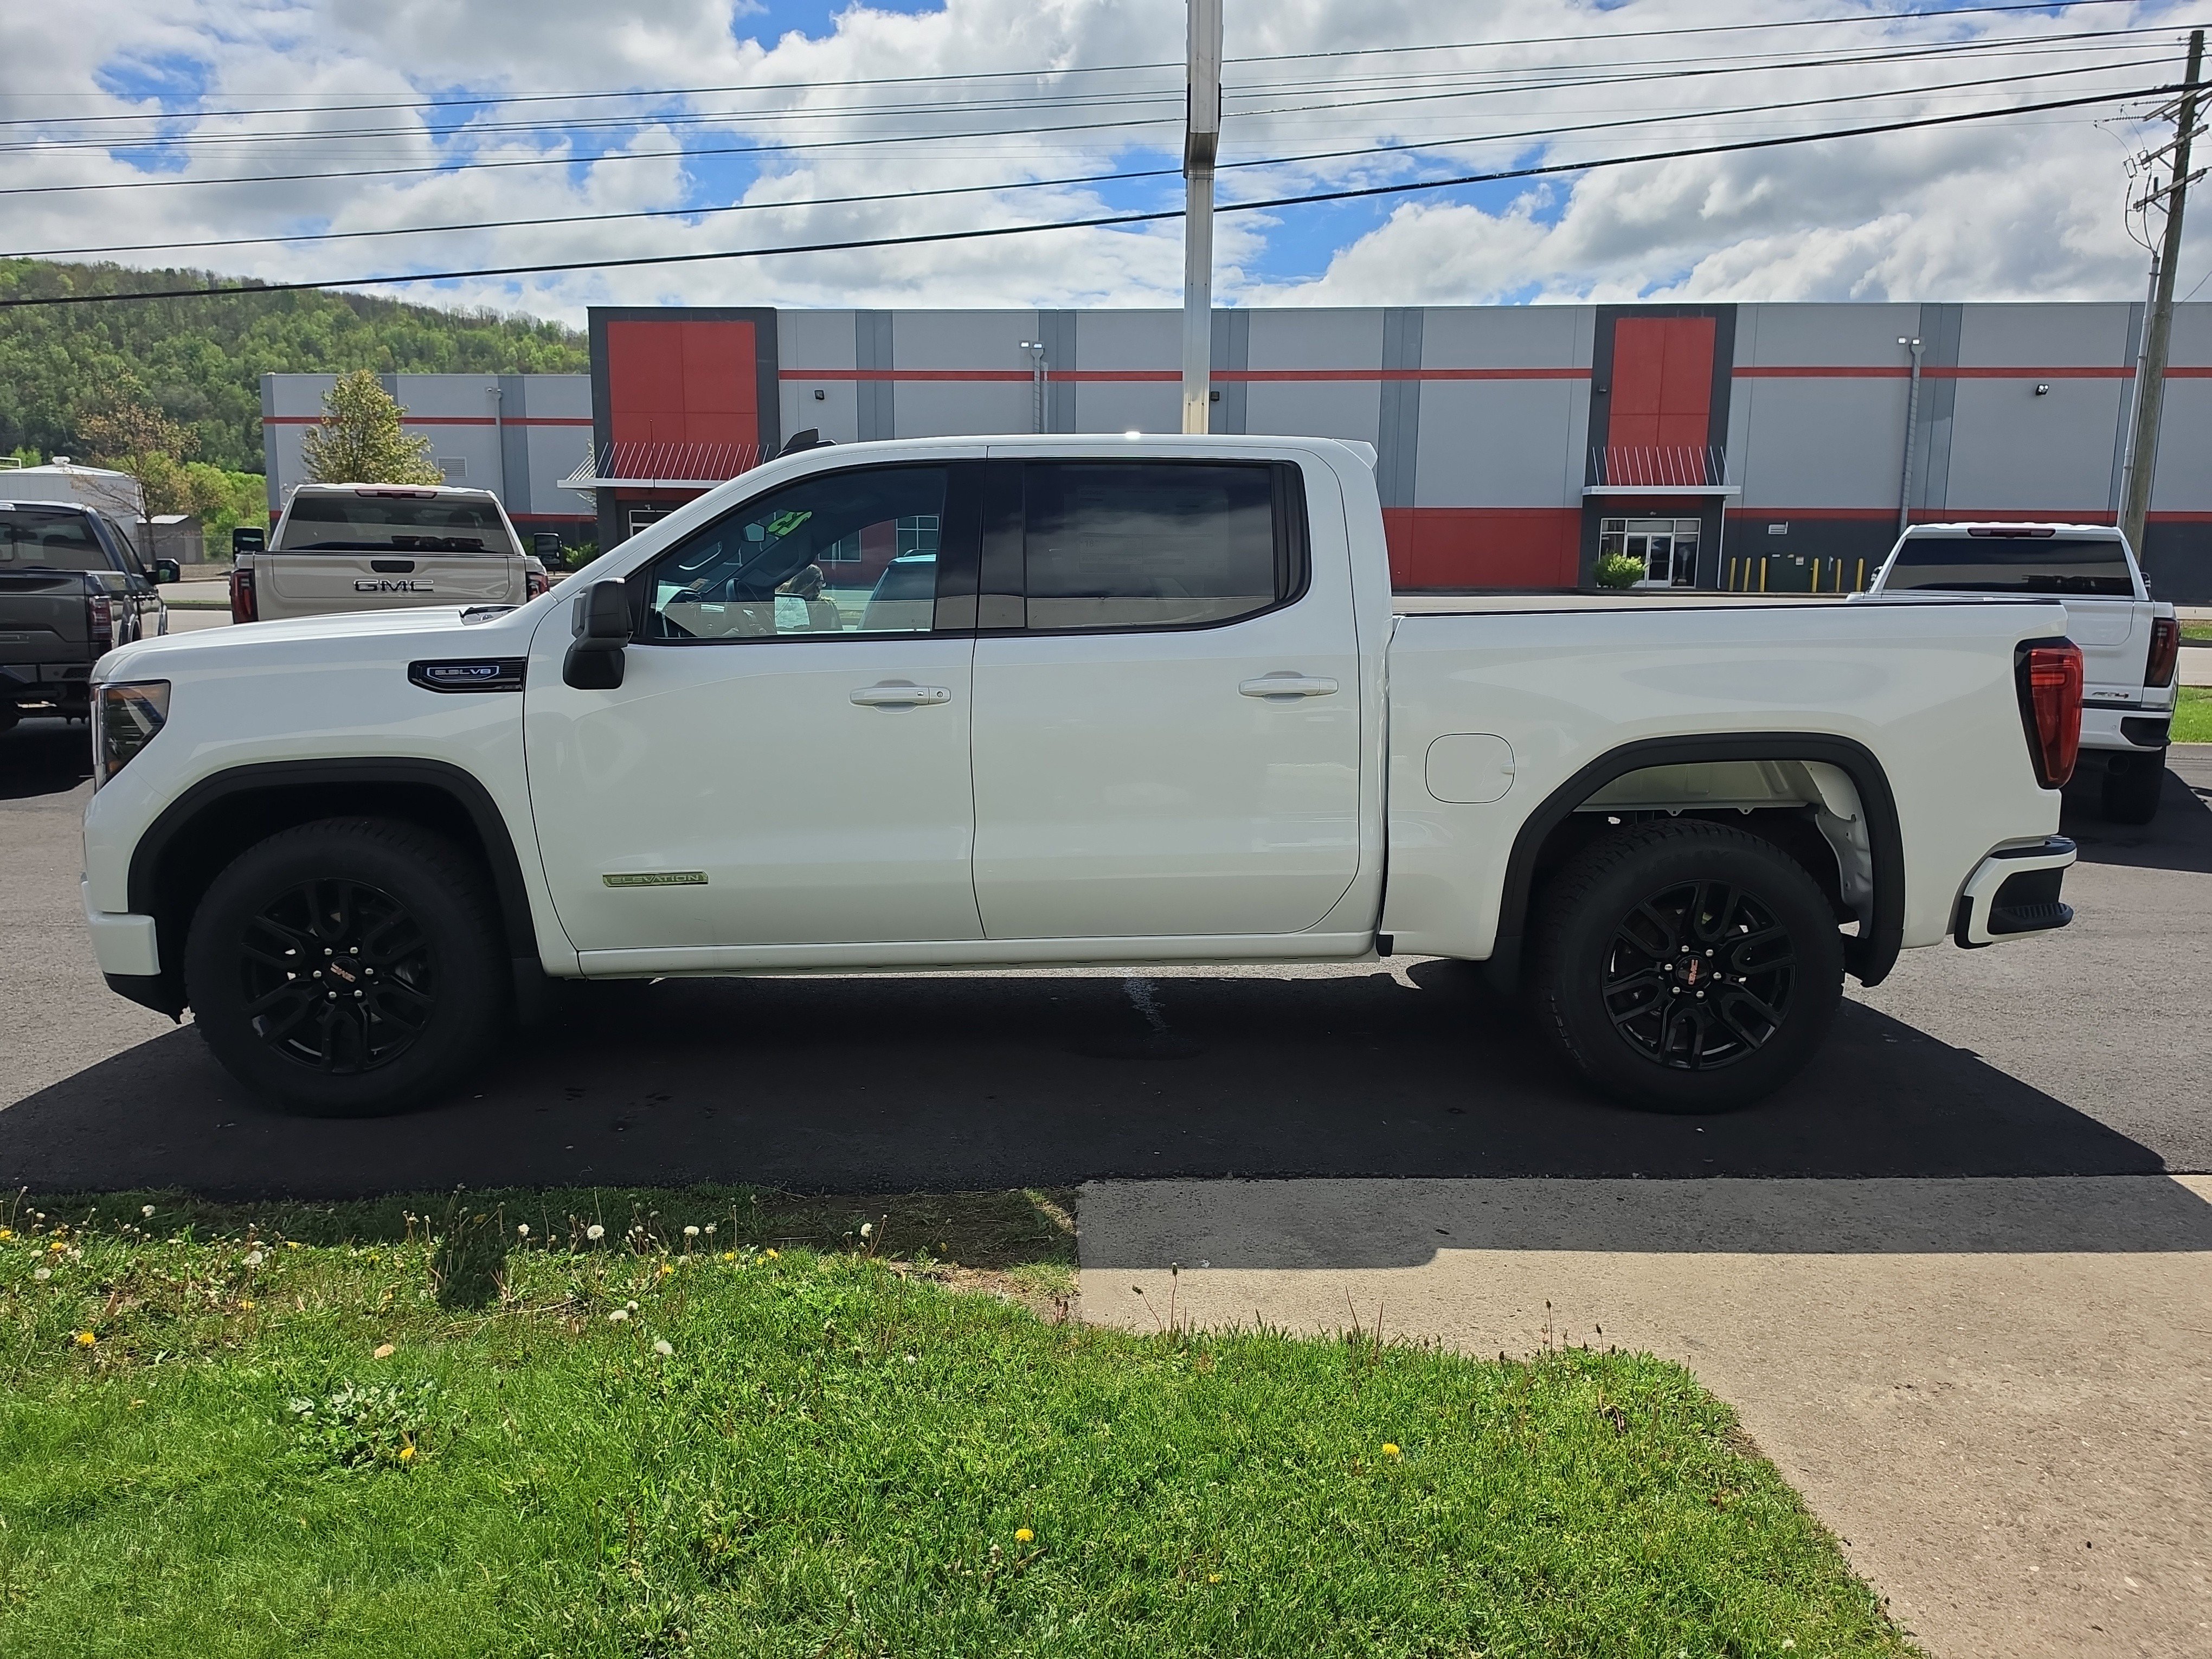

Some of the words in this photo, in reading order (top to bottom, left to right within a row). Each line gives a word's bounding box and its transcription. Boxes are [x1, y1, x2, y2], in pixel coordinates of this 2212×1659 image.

[353, 579, 434, 593] GMC
[611, 873, 698, 884] ELEVATION
[330, 962, 356, 982] GMC
[1688, 959, 1698, 985] GMC
